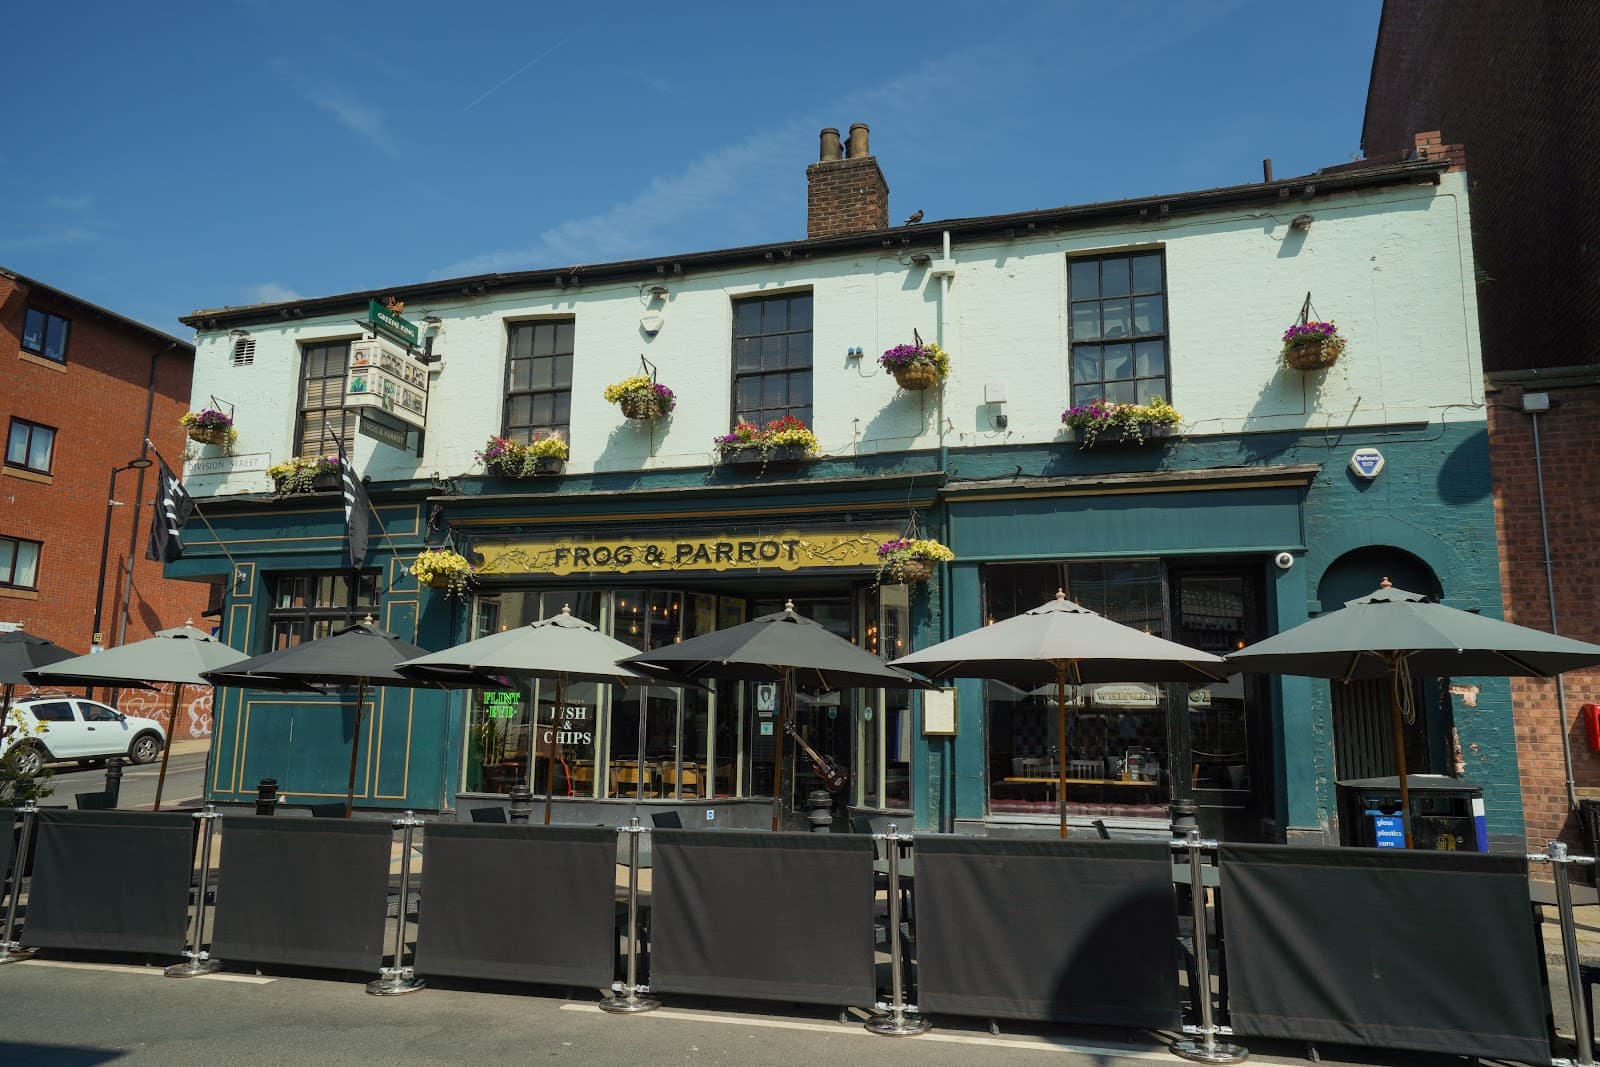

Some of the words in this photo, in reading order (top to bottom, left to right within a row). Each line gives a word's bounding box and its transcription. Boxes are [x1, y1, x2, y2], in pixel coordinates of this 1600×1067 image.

[377, 312, 400, 330] GREENE
[400, 324, 415, 338] KING
[188, 461, 225, 472] DIVISION
[230, 458, 259, 469] STREET
[554, 545, 632, 568] FROG
[644, 544, 666, 565] &
[676, 540, 800, 563] PARROT
[483, 691, 520, 705] FLINT
[563, 720, 573, 730] &
[543, 731, 592, 745] CHIPS
[1376, 819, 1394, 827] glass
[1377, 829, 1403, 838] plastics
